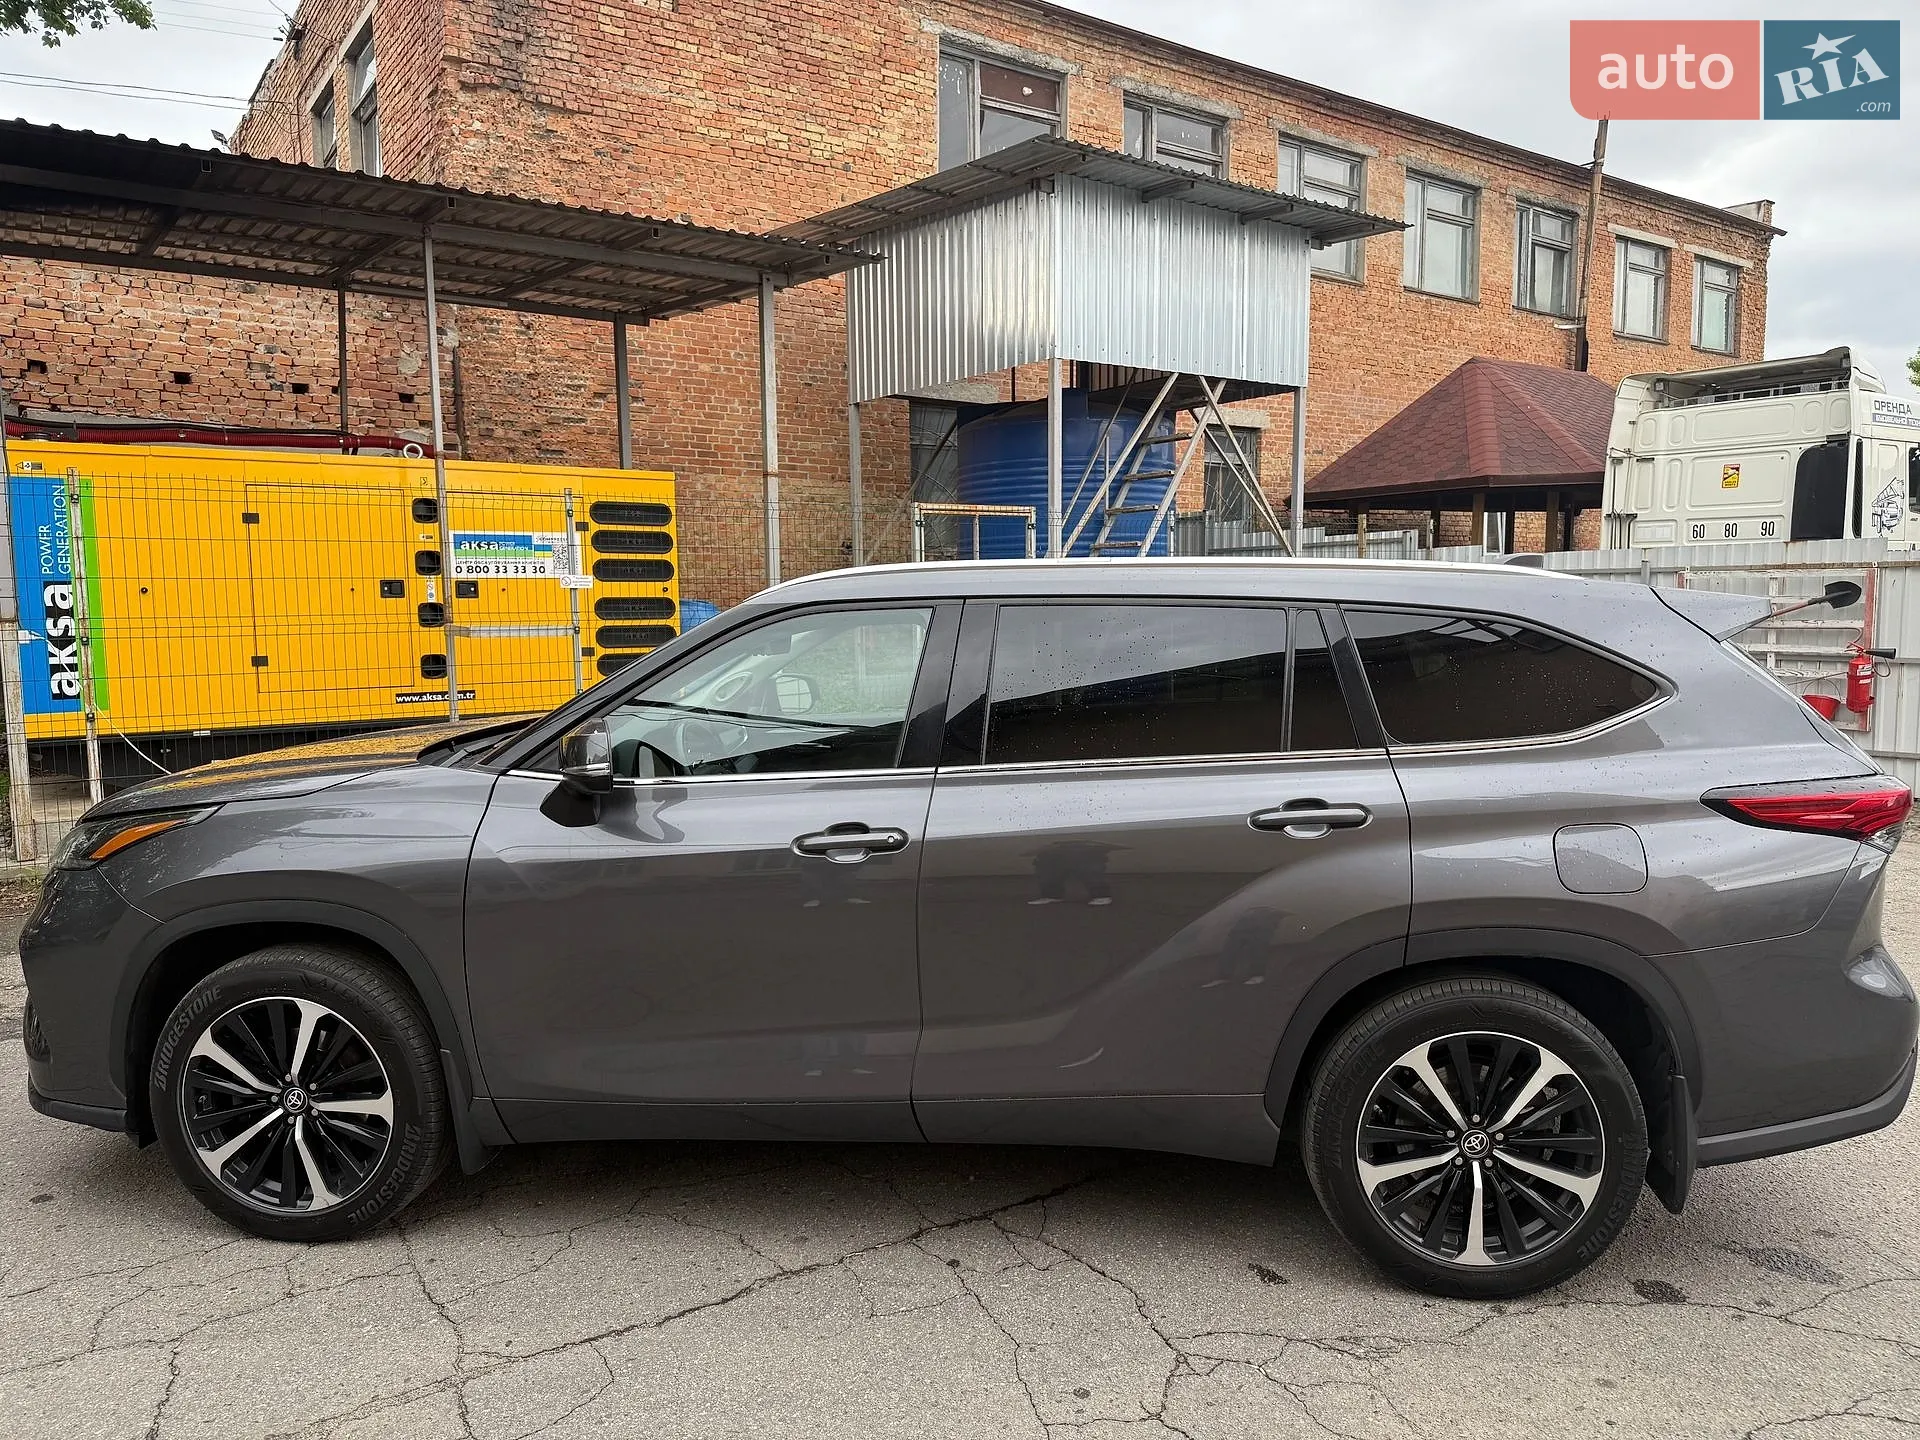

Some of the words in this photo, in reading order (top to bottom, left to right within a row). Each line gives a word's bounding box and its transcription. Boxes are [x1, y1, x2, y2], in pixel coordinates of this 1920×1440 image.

[1874, 400, 1912, 415] ОРЕНДА
[52, 485, 71, 574] GENERATION
[460, 540, 499, 551] aksa
[1692, 523, 1705, 539] 60
[1724, 522, 1738, 538] 80
[1760, 521, 1775, 536] 90
[39, 524, 55, 575] POWER
[455, 565, 463, 574] 0
[466, 565, 490, 574] 800
[494, 565, 508, 574] 33
[513, 565, 527, 574] 33
[532, 565, 546, 574] 30
[44, 583, 81, 697] aksa
[396, 692, 475, 702] www.aksa.cm.tr
[154, 984, 223, 1092] BRIDGESTONE
[347, 1122, 421, 1227] BRIDGESTONE
